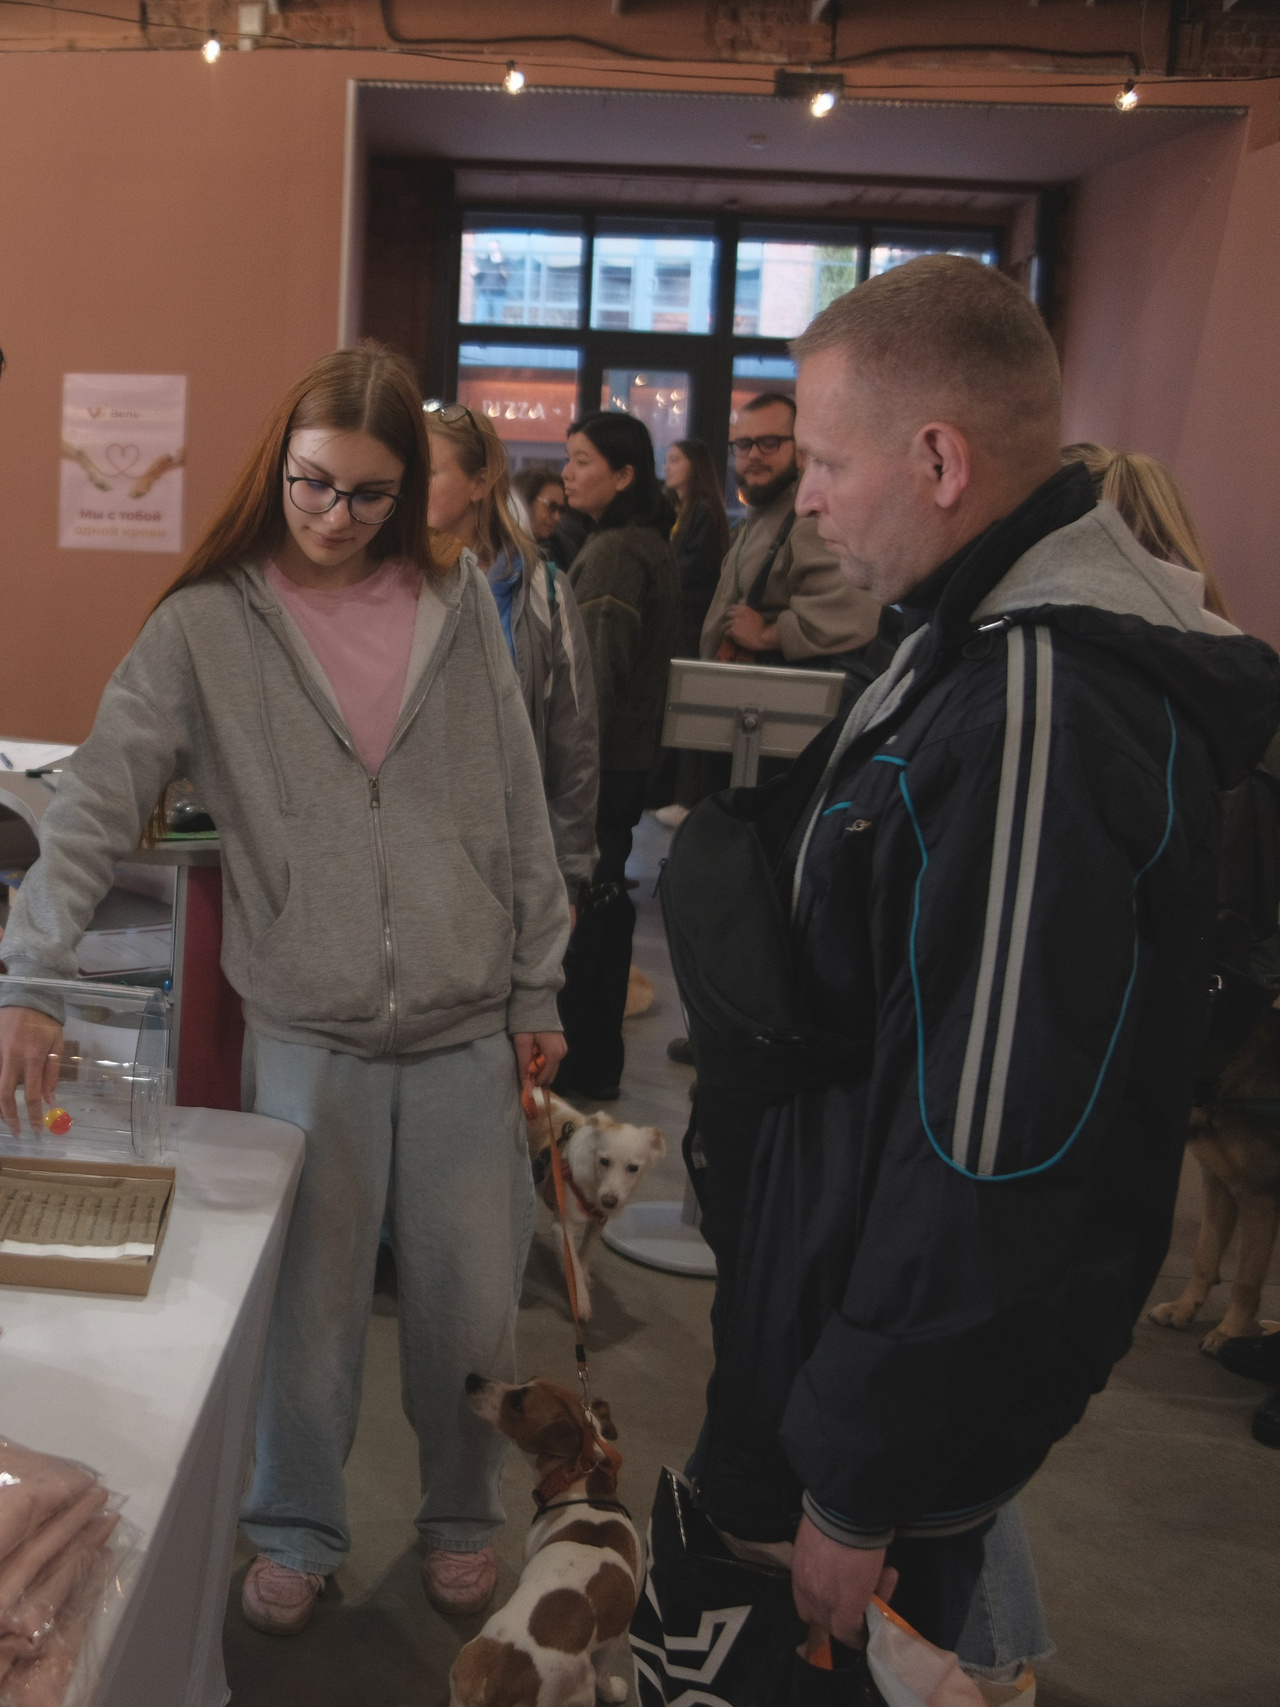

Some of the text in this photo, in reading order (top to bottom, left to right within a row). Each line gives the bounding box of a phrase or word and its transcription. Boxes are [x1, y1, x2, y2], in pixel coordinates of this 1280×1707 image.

[80, 509, 162, 522] Мы с тобой
